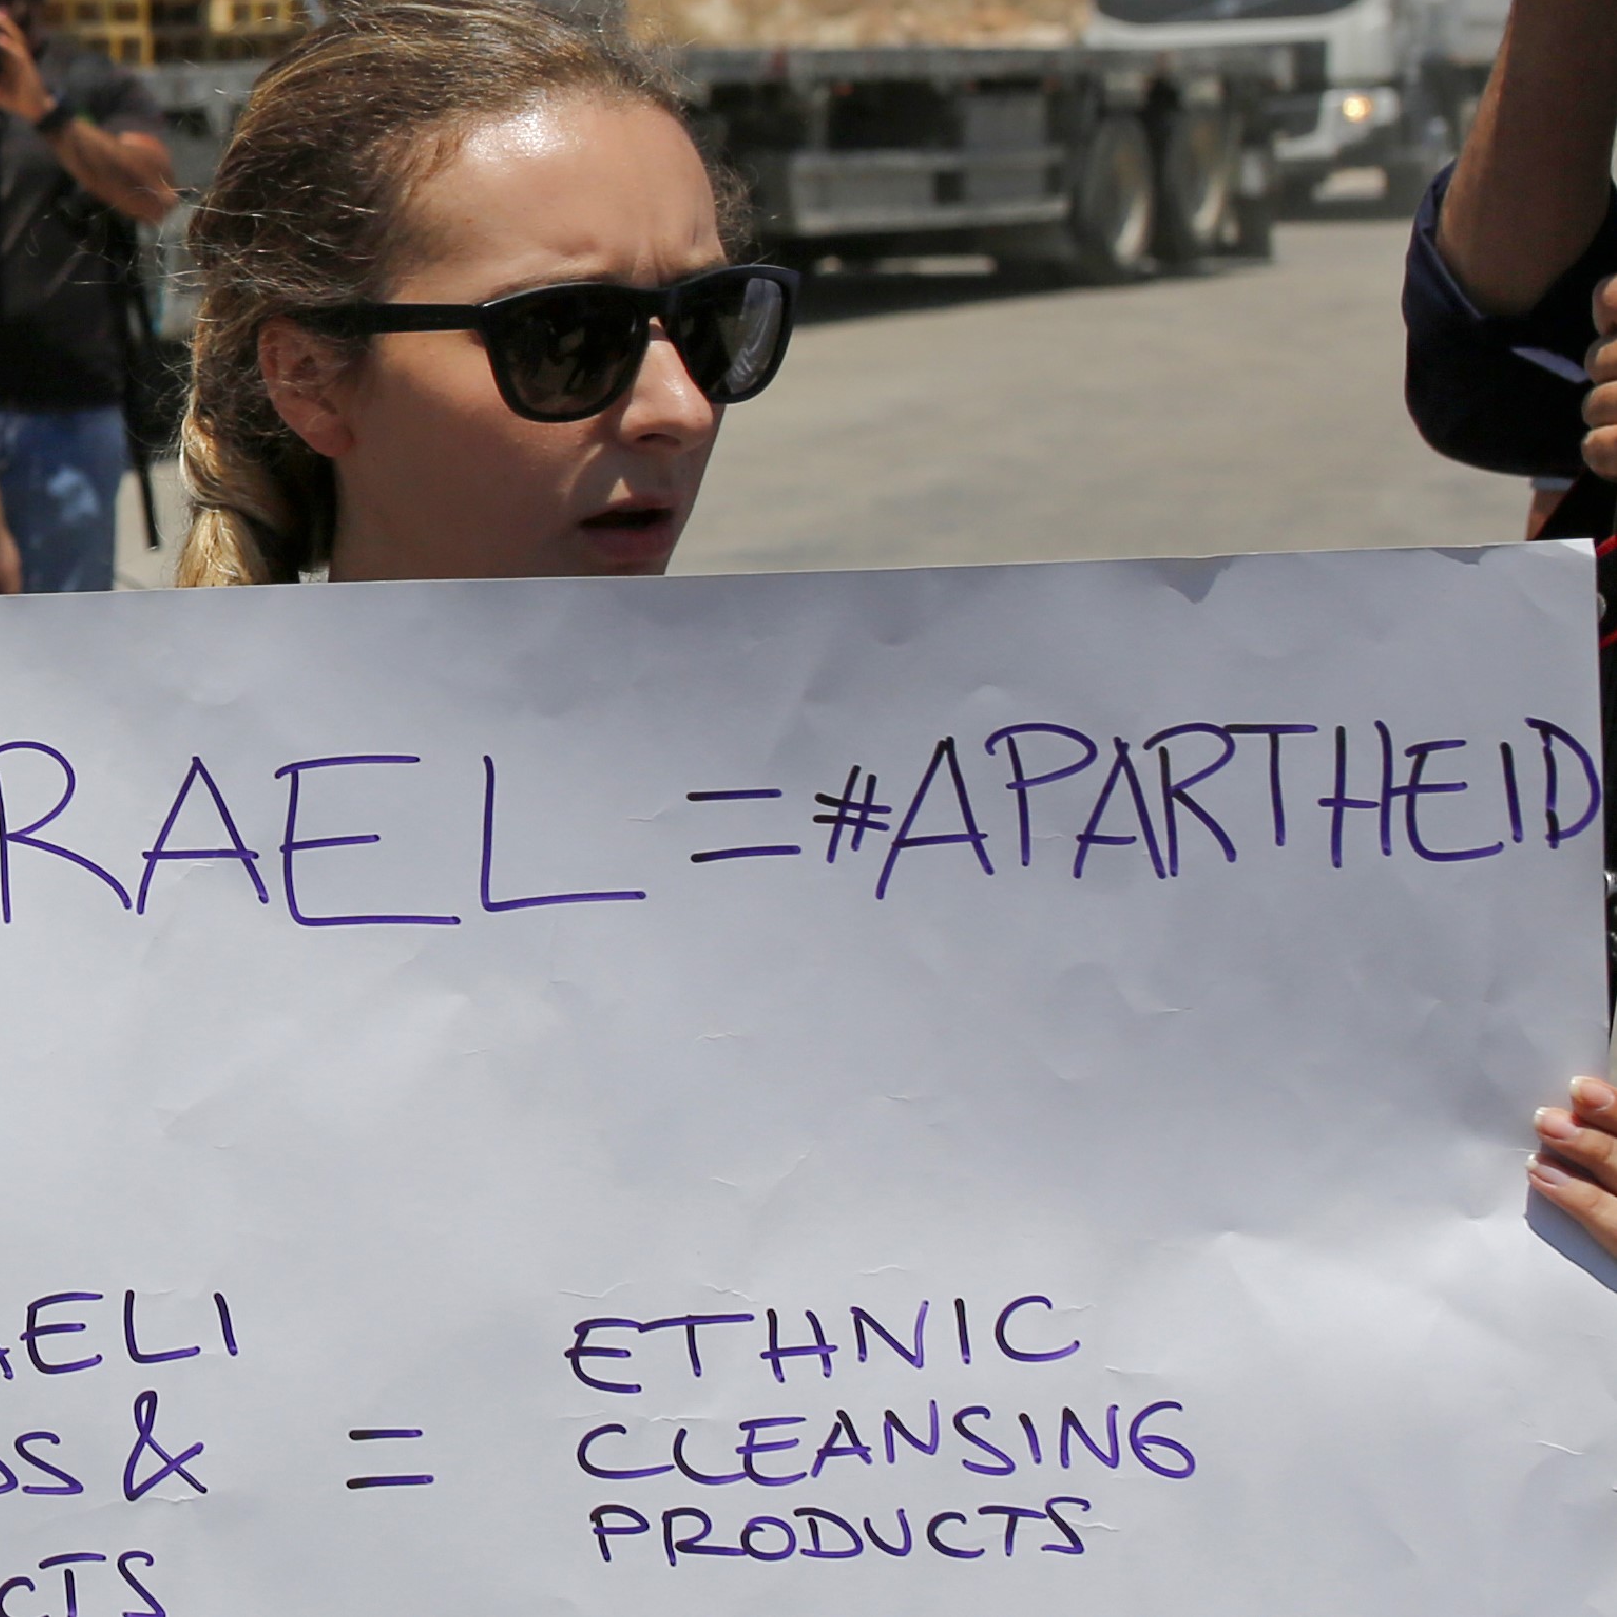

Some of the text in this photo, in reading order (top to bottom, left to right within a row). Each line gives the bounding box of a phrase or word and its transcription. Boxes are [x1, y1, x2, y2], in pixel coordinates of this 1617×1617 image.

[564, 1295, 1082, 1394] ETHNIC
[122, 1390, 208, 1502] &
[577, 1399, 1197, 1488] CLEANSING
[589, 1495, 1092, 1567] PRODUCTS
